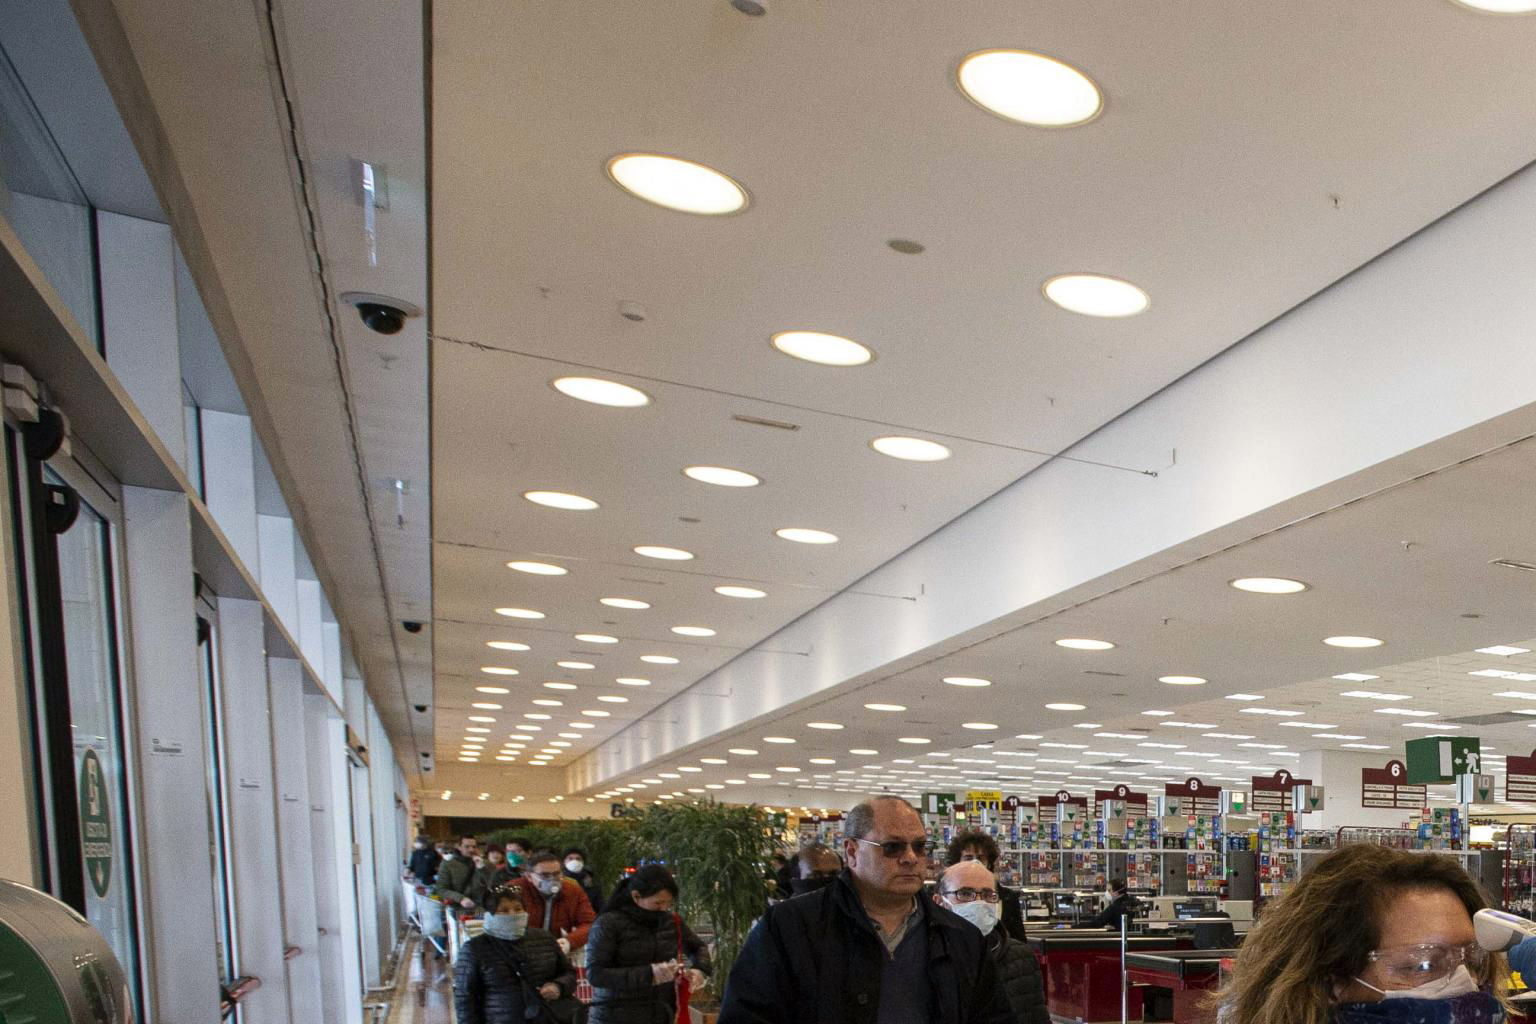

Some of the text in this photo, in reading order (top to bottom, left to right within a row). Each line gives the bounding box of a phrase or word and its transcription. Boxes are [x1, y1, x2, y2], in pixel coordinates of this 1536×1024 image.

[1391, 763, 1401, 777] 6
[1279, 772, 1288, 785] 7
[1190, 780, 1198, 791] 8
[1057, 792, 1069, 802] 10
[1118, 787, 1126, 797] 9
[1009, 797, 1018, 806] 11
